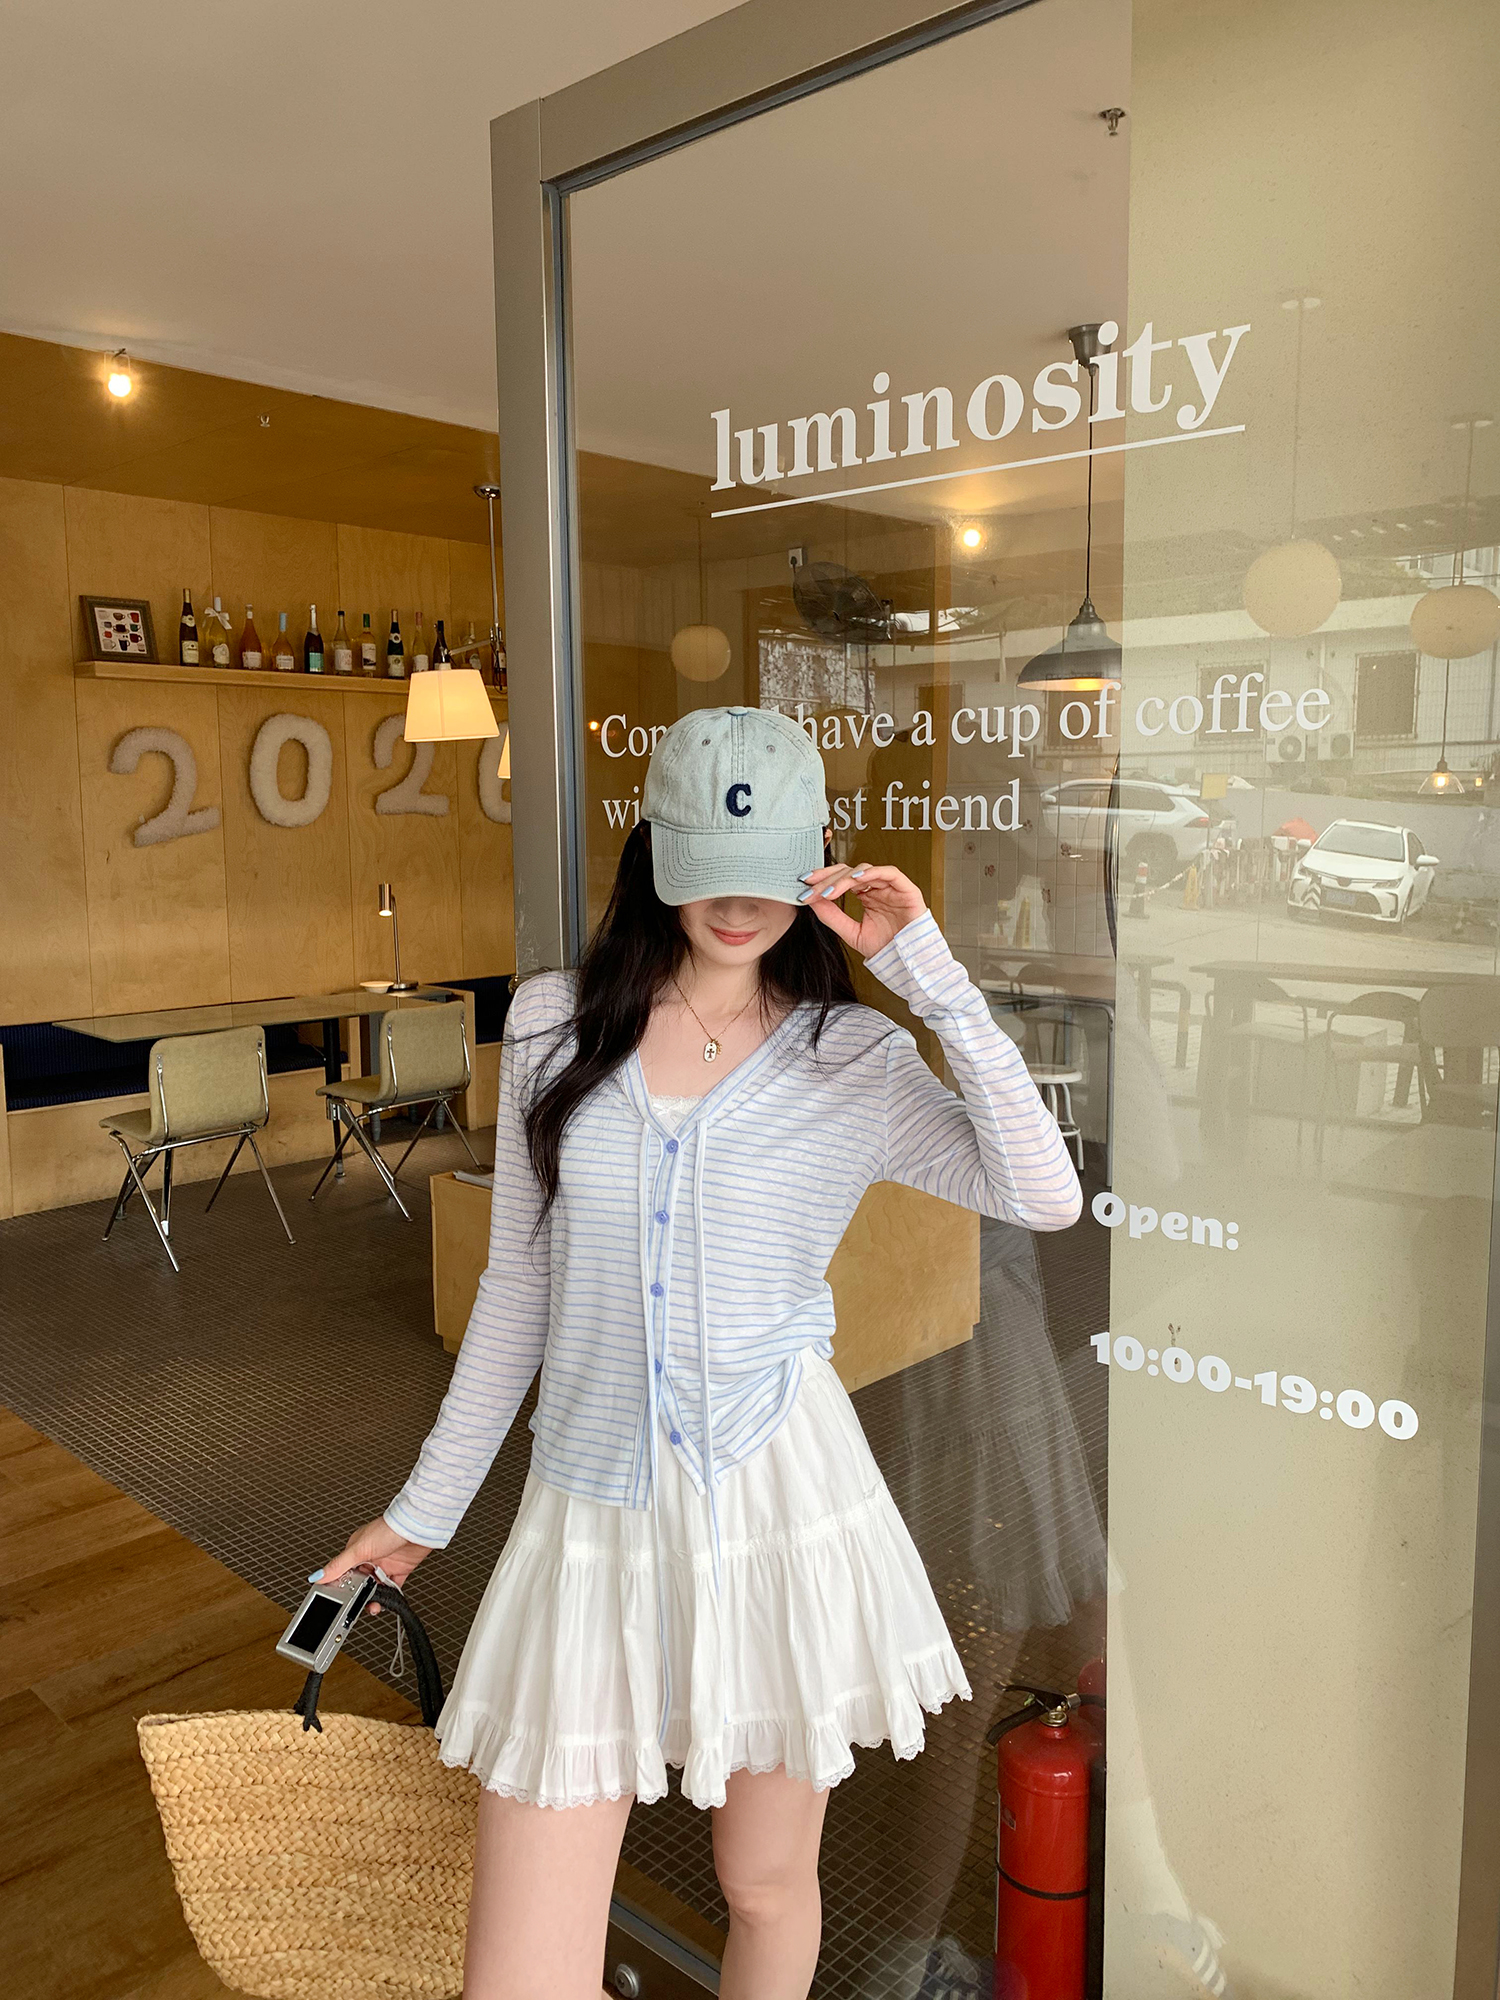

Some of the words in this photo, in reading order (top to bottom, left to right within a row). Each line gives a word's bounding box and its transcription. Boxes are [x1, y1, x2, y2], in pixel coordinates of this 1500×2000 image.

[710, 320, 1251, 492] luminosity
[795, 702, 895, 750] have
[911, 710, 936, 747] a
[951, 703, 1041, 758] cup
[1059, 682, 1122, 740] of
[1135, 672, 1332, 736] coffee
[602, 785, 640, 829] wi
[833, 787, 868, 831] st
[881, 779, 1023, 832] friend
[1091, 1191, 1239, 1250] Open:
[1089, 1331, 1419, 1440] 10:00-19:00
